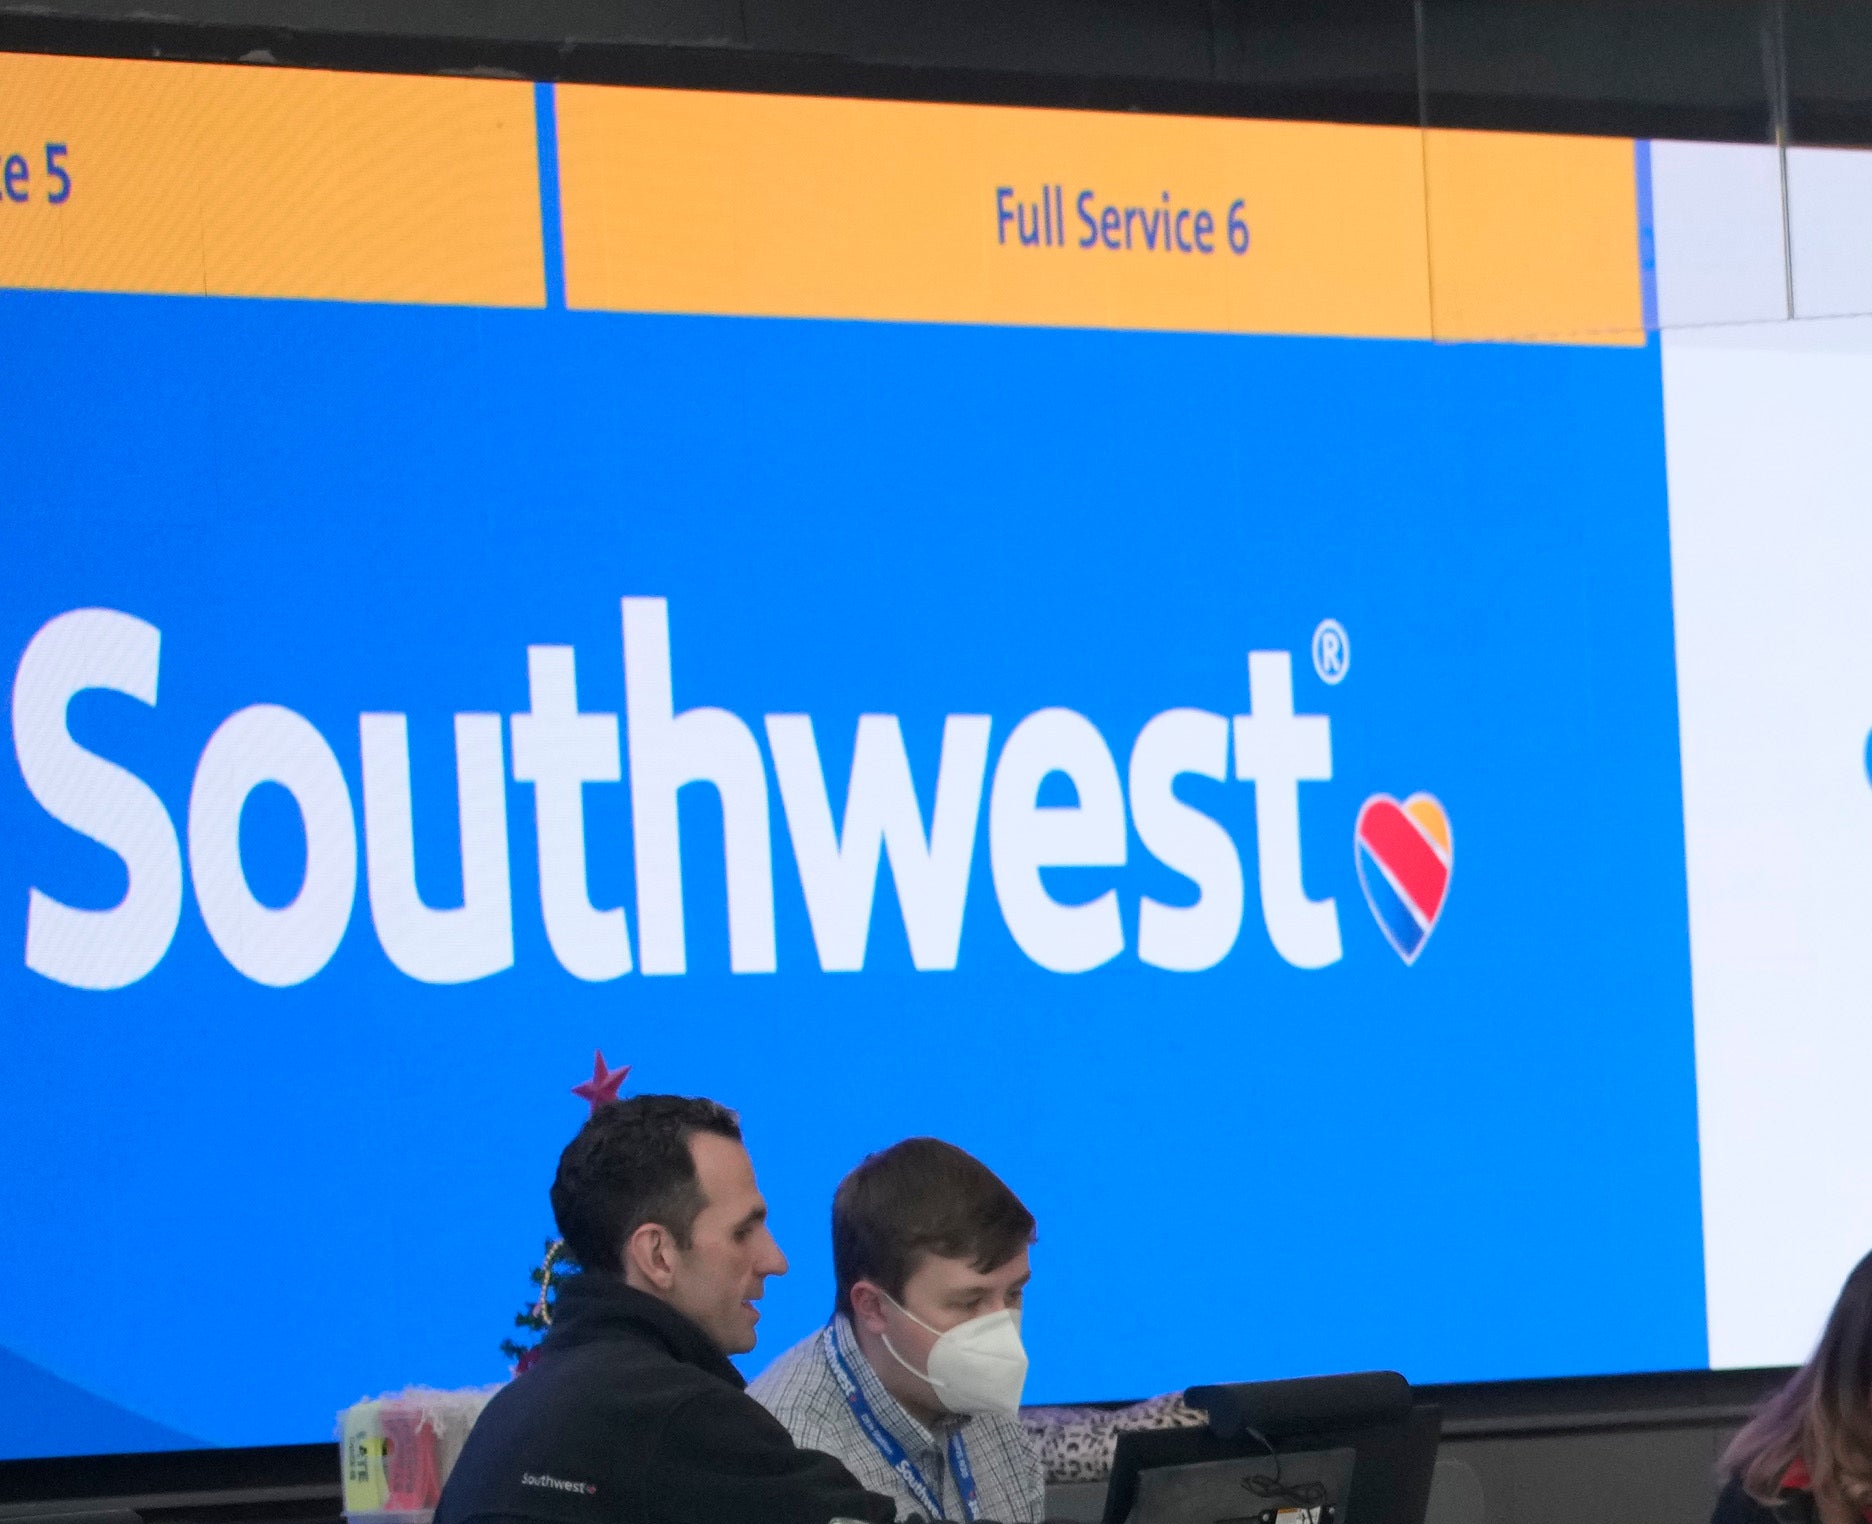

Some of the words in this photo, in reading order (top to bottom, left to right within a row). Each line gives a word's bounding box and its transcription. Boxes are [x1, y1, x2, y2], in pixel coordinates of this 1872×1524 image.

[0, 153, 29, 203] e
[45, 141, 71, 206] 5
[996, 184, 1064, 247] Full
[1077, 190, 1215, 254] Service
[1226, 198, 1250, 255] 6
[521, 1472, 585, 1494] Southwest
